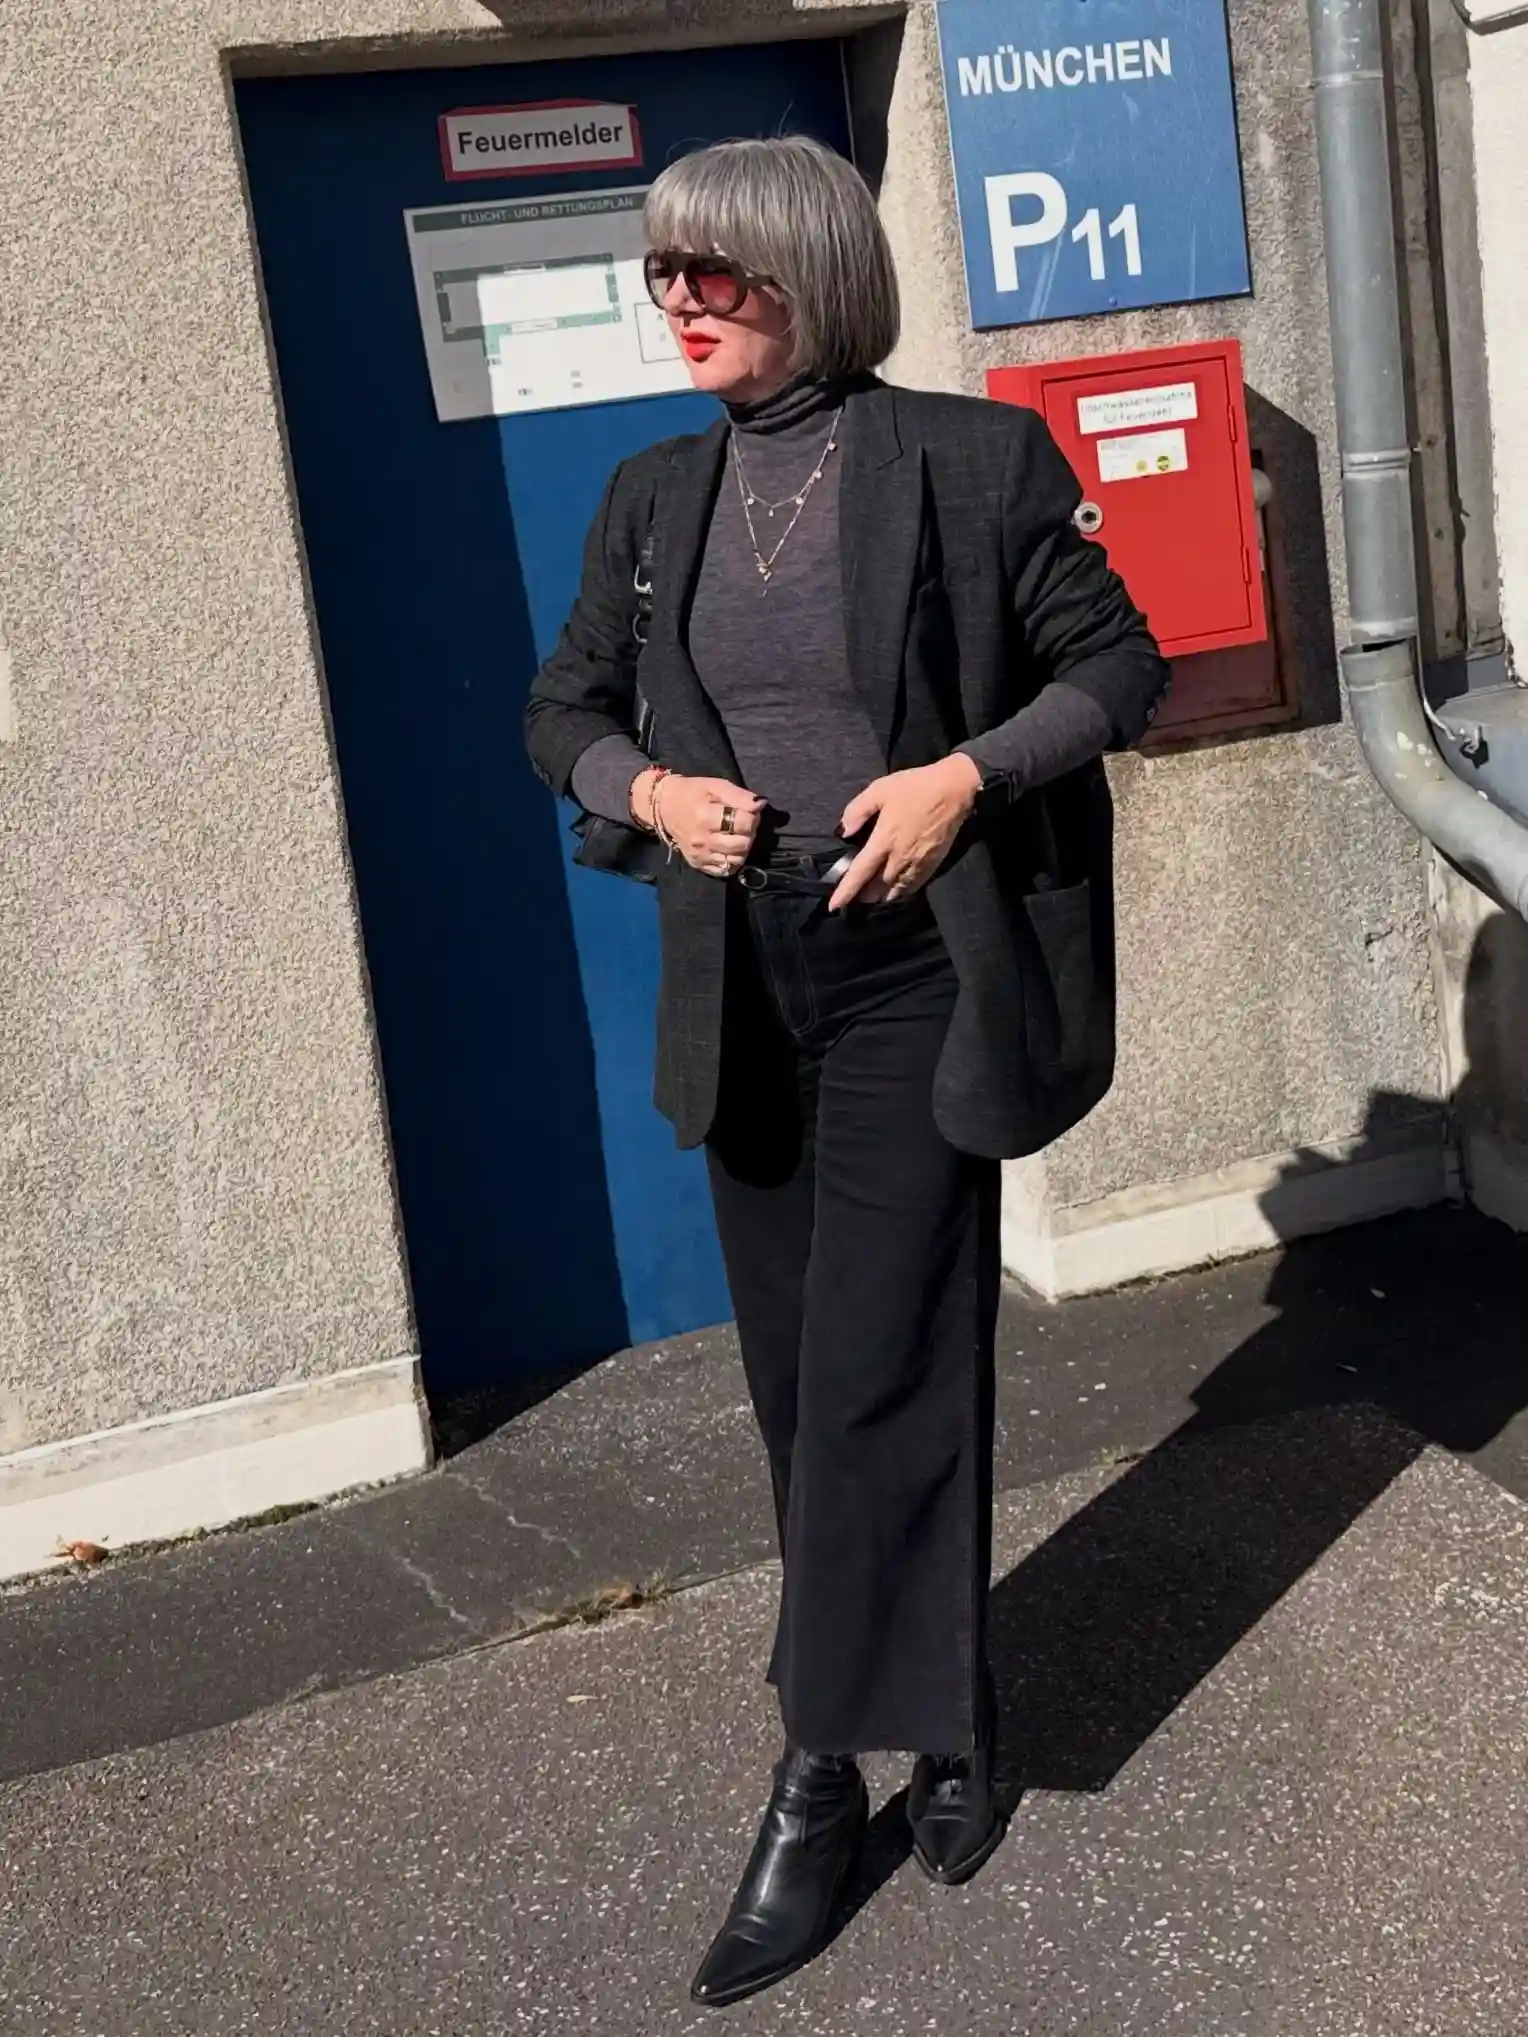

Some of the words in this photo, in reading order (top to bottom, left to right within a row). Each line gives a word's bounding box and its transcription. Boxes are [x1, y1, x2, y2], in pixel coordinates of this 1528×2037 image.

[957, 37, 1172, 97] MÜNCHEN
[457, 121, 623, 155] Feuermelder
[513, 207, 540, 219] UND
[541, 197, 634, 216] RETTUNGSPLAN
